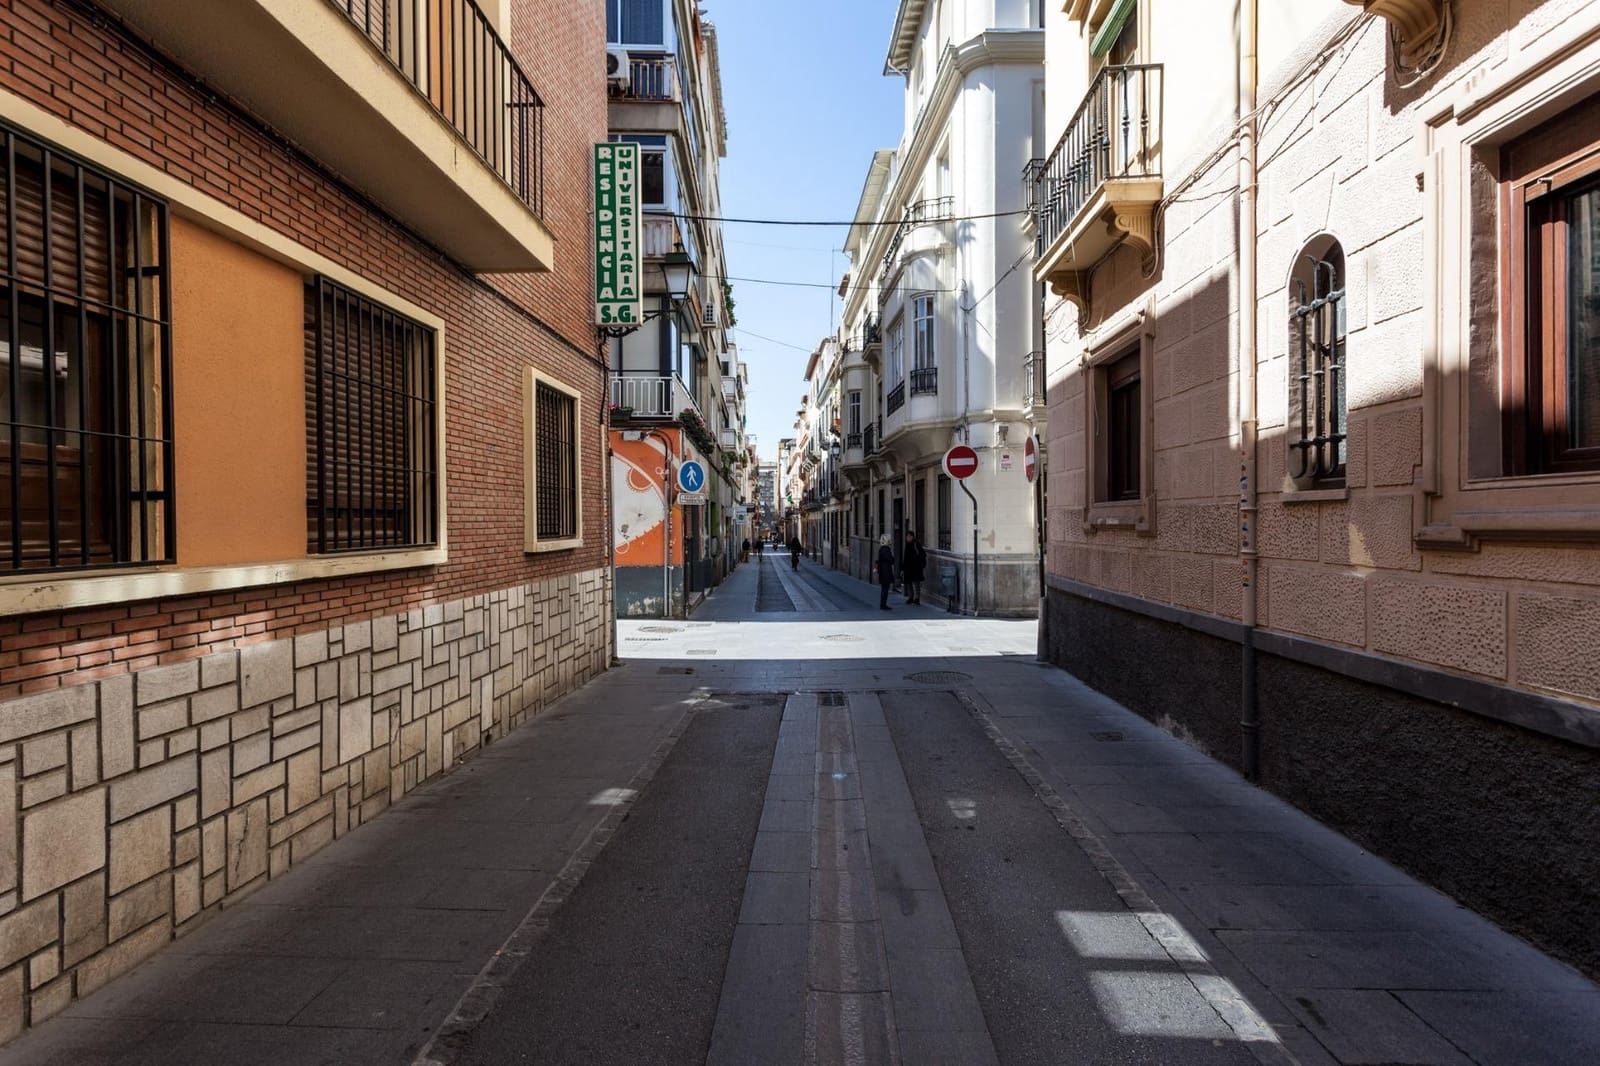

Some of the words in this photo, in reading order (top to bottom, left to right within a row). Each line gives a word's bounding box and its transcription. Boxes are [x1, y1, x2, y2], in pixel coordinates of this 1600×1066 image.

[598, 147, 615, 299] RESIDENCIA
[619, 149, 633, 296] UNIVERSITARIA
[601, 305, 637, 323] S.G.
